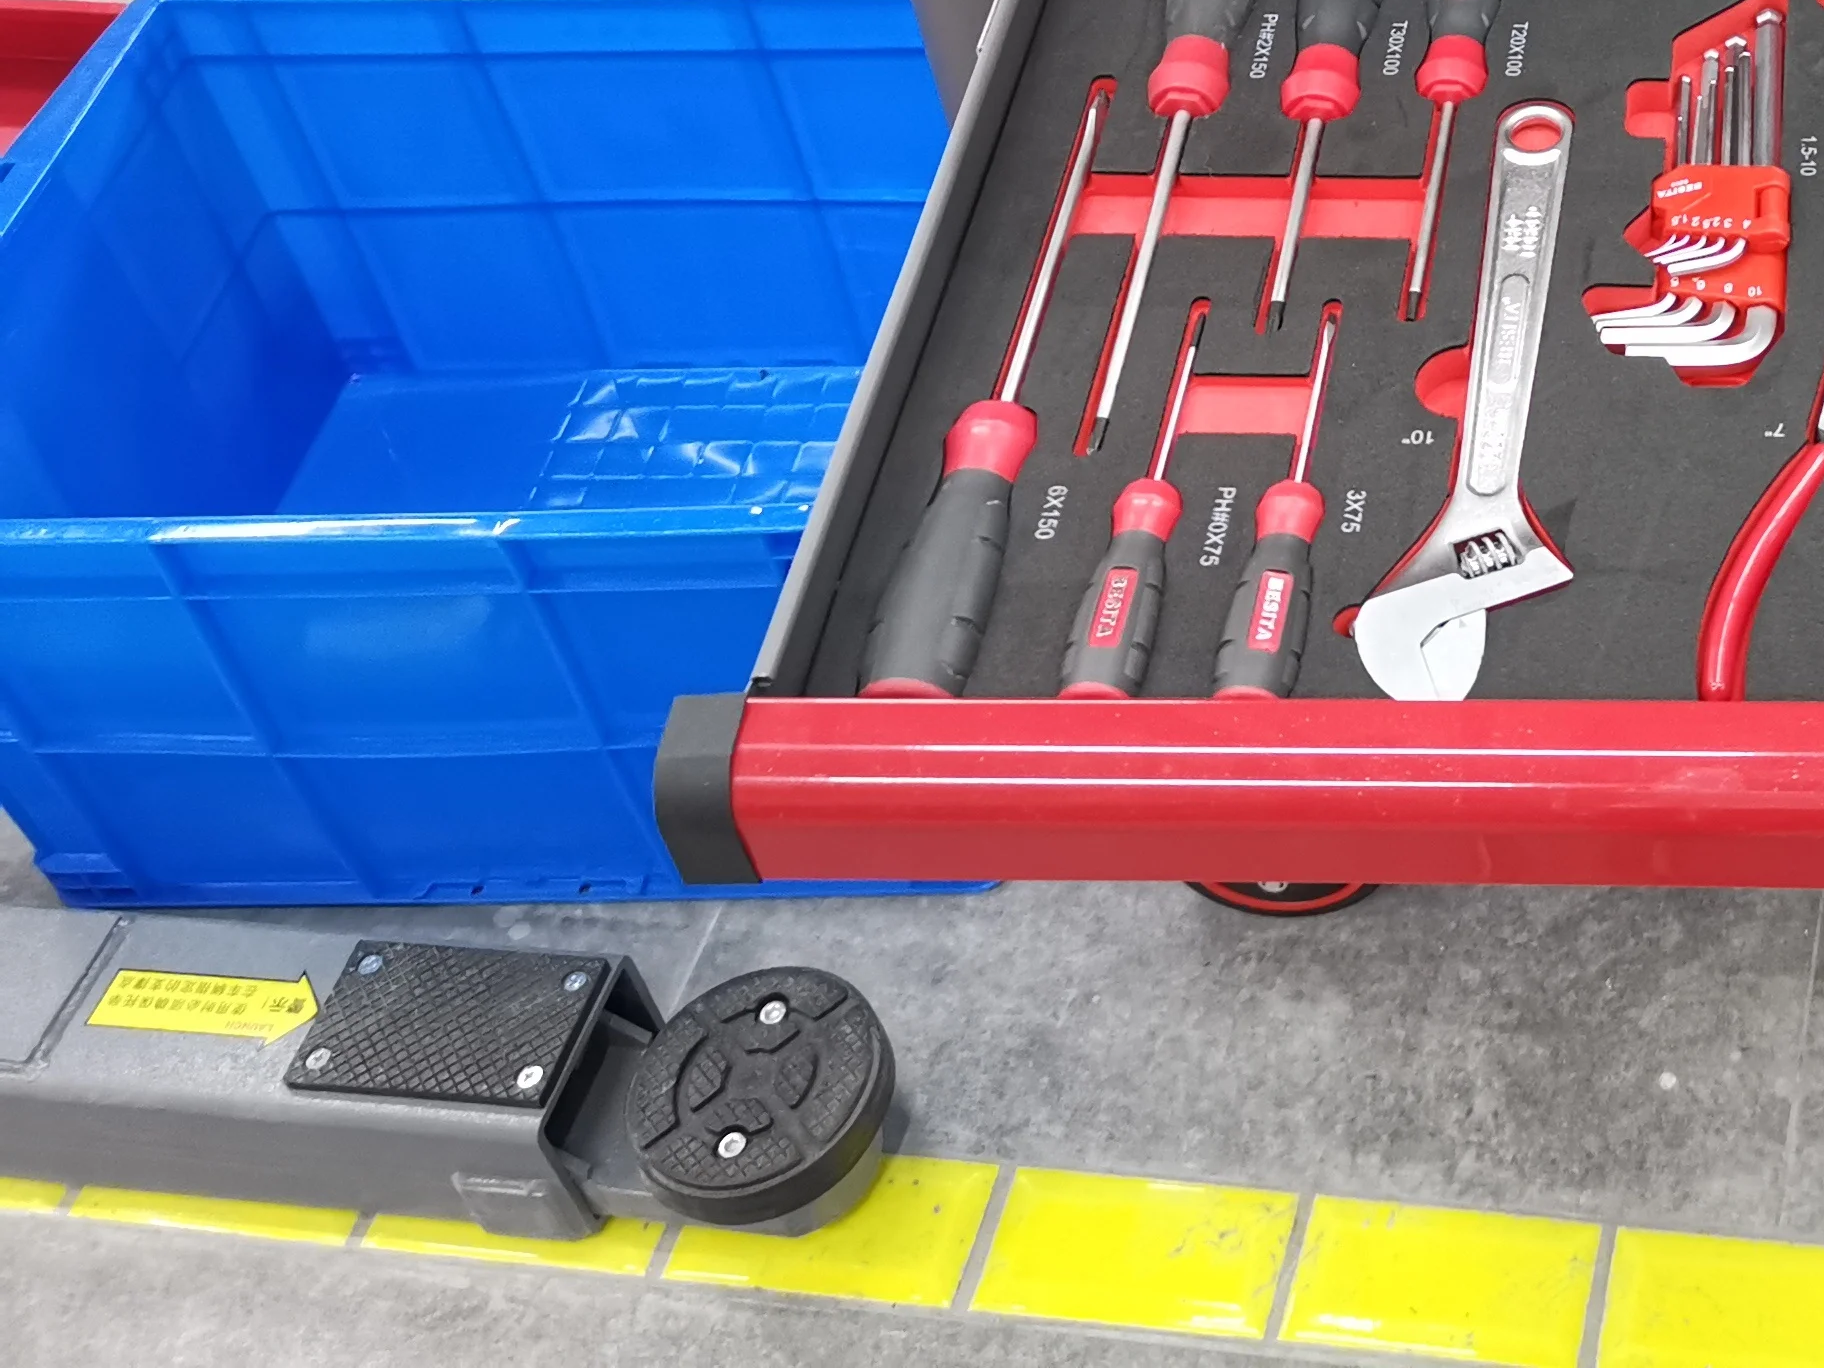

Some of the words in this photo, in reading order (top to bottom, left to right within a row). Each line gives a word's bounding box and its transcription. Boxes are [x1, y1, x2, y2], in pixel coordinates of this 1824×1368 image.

[1381, 20, 1409, 75] T30X100
[1503, 22, 1529, 76] T20X100
[1801, 136, 1817, 177] 1.5-10
[1034, 485, 1068, 540] 6X150
[1340, 490, 1366, 533] 3X75
